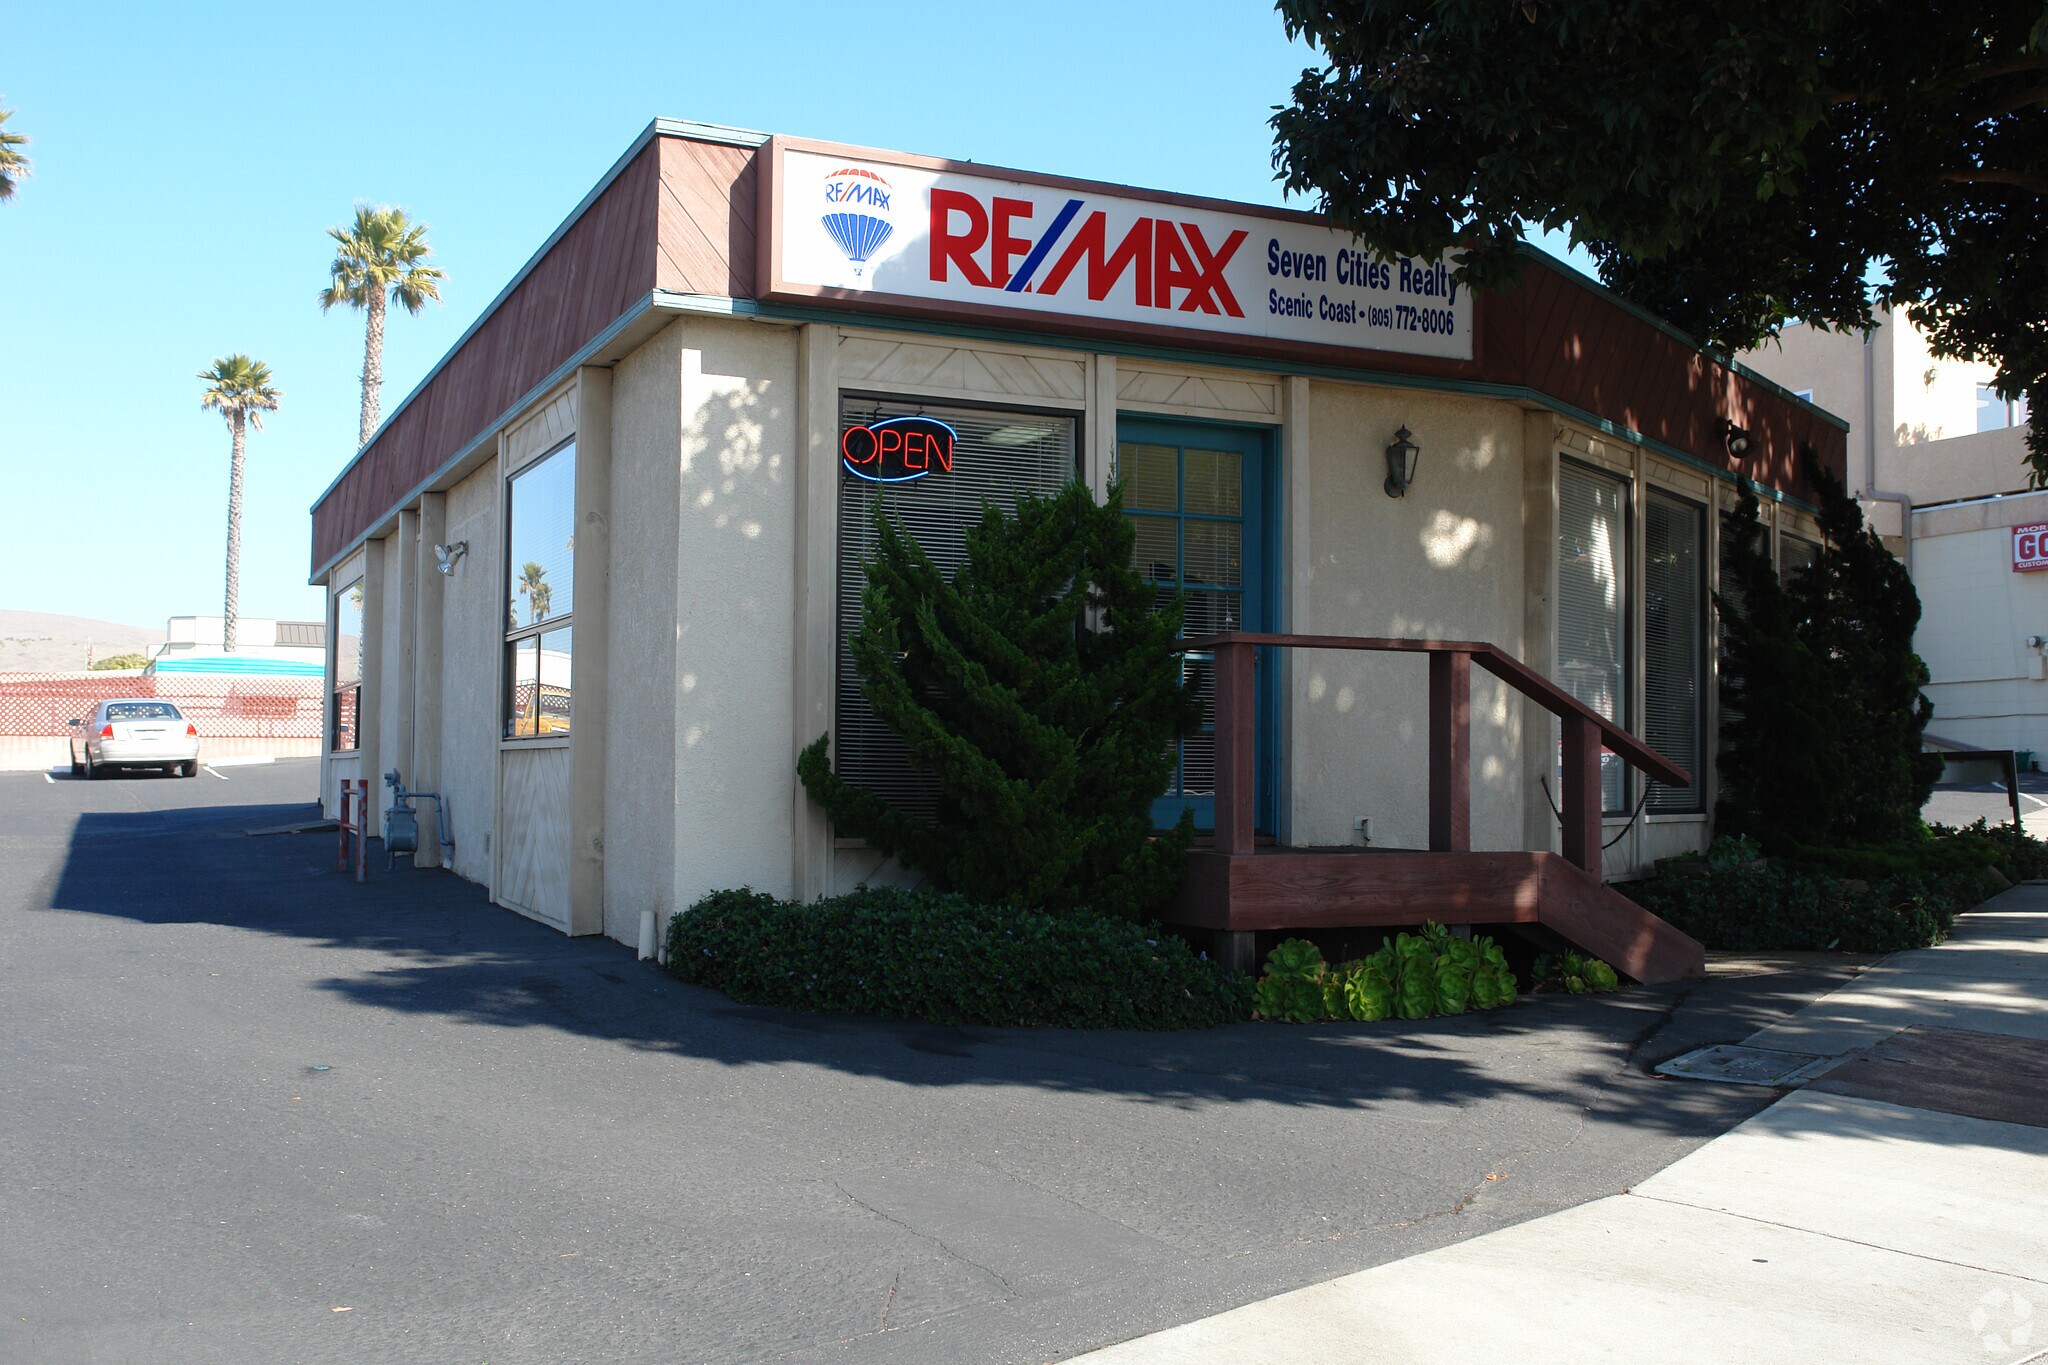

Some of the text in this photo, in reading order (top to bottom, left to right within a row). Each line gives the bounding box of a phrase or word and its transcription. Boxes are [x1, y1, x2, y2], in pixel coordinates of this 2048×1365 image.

[929, 187, 1250, 319] RE/MAX
[1267, 238, 1457, 306] Seven Cities Realty
[1268, 287, 1454, 336] Scenic Coast (805) 772-8006
[842, 425, 953, 471] OPEN
